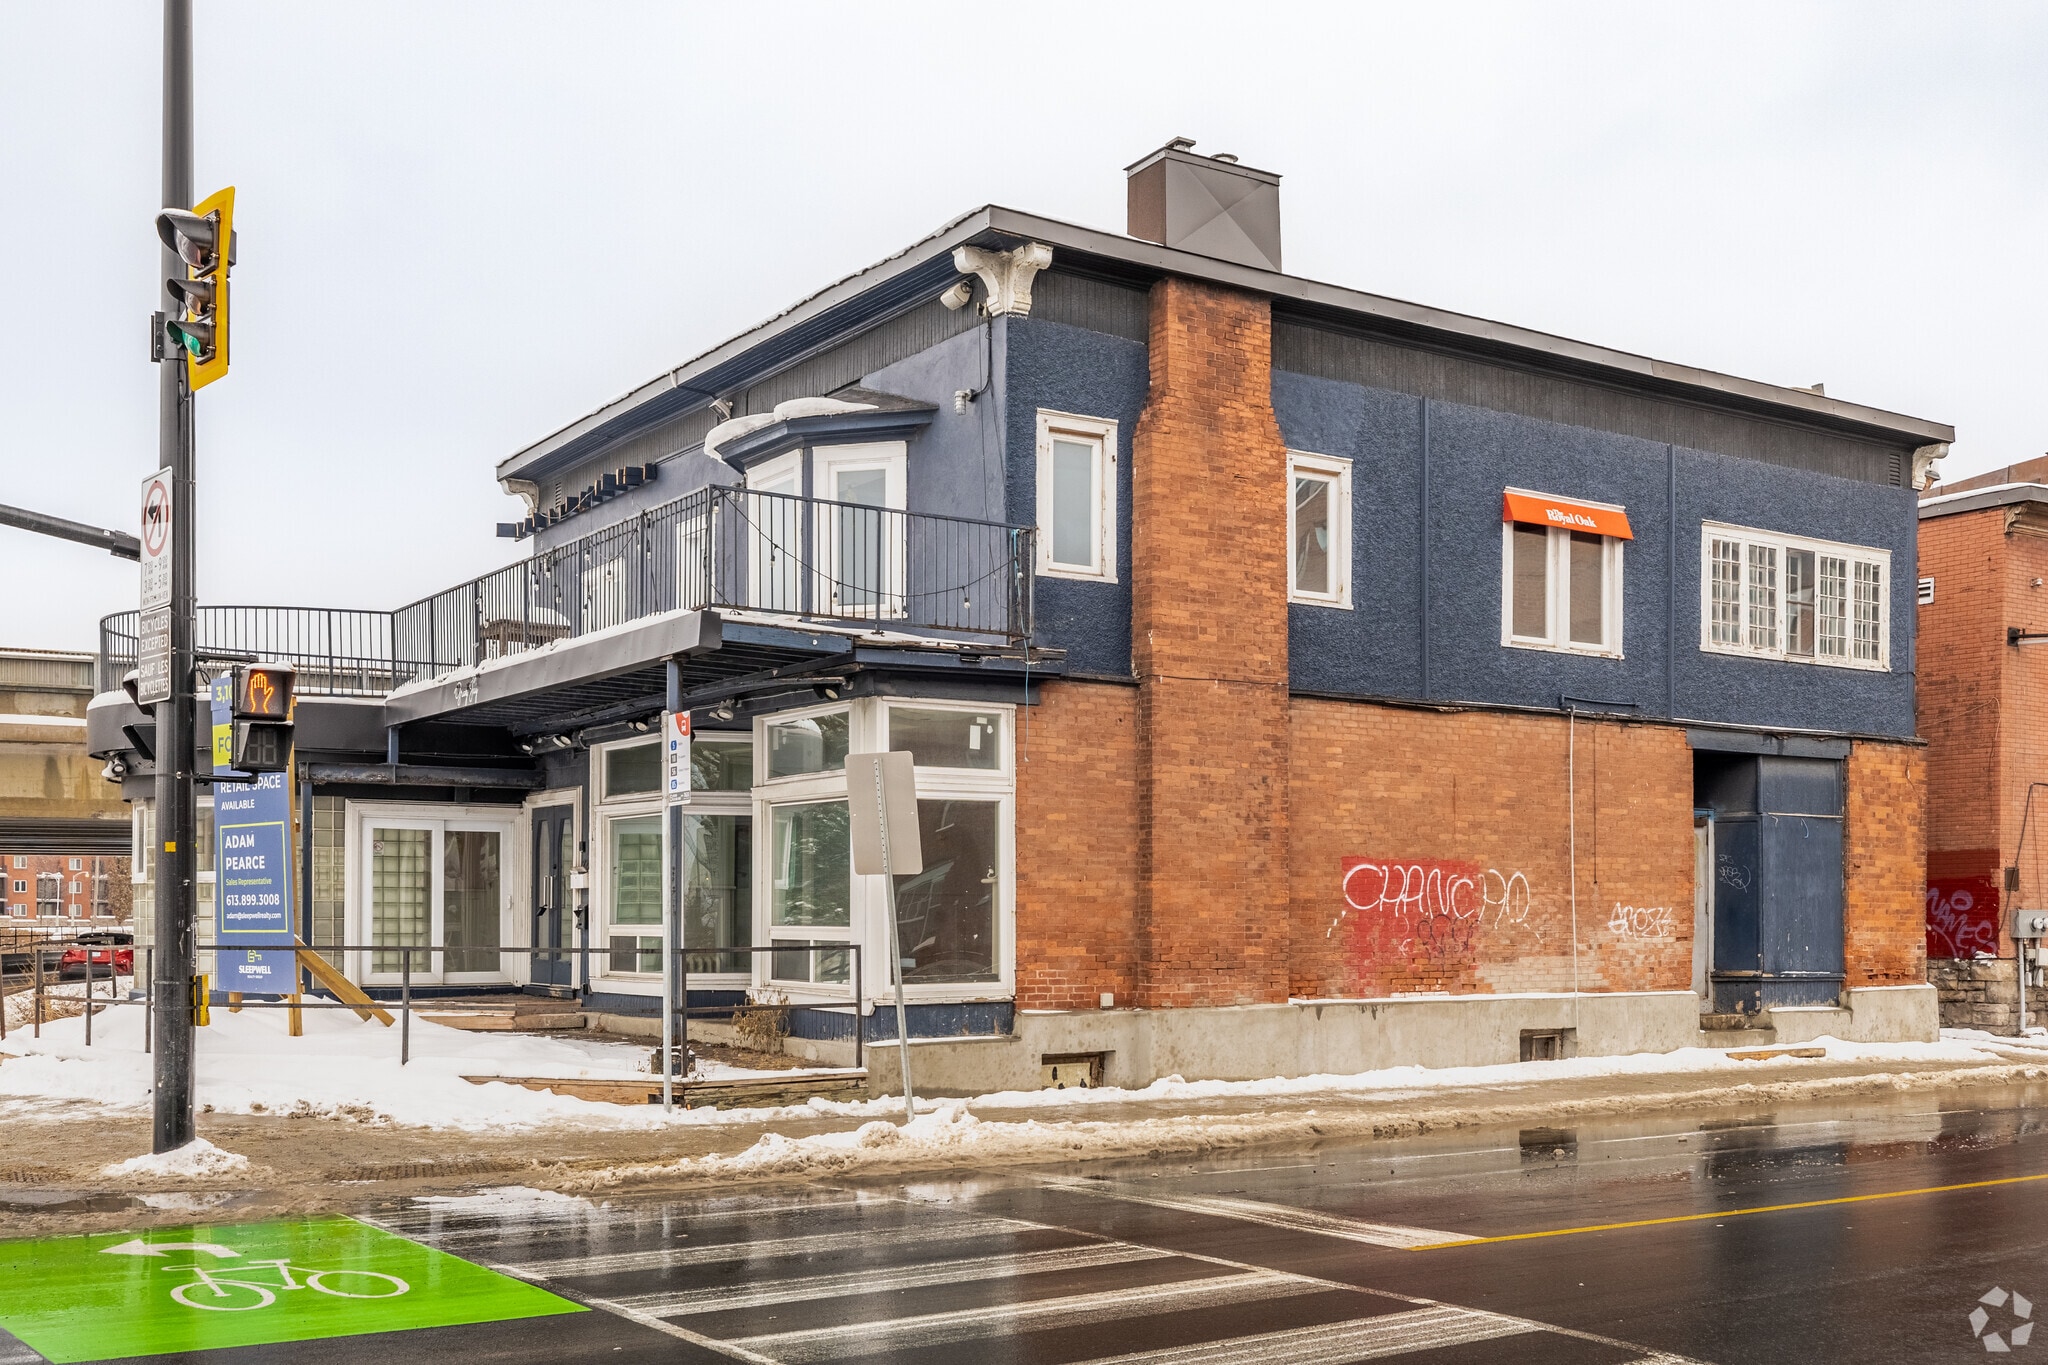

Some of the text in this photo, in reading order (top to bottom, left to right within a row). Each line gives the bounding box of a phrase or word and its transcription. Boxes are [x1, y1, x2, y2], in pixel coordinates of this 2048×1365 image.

[1545, 509, 1597, 528] Royal Oak
[141, 615, 168, 635] BICYCLES
[141, 633, 168, 652] EXCEPTED
[141, 660, 168, 678] SAUF LES
[140, 677, 168, 696] BICYCLETTES
[221, 799, 255, 811] AVAILABLE
[225, 834, 255, 849] ADAM
[225, 856, 265, 871] PEARCE
[226, 877, 272, 887] Sales Representative
[226, 893, 280, 906] 613.899.3008
[226, 911, 282, 920] adam@sleepwellrealty.com
[239, 965, 272, 974] SLEEPWELL
